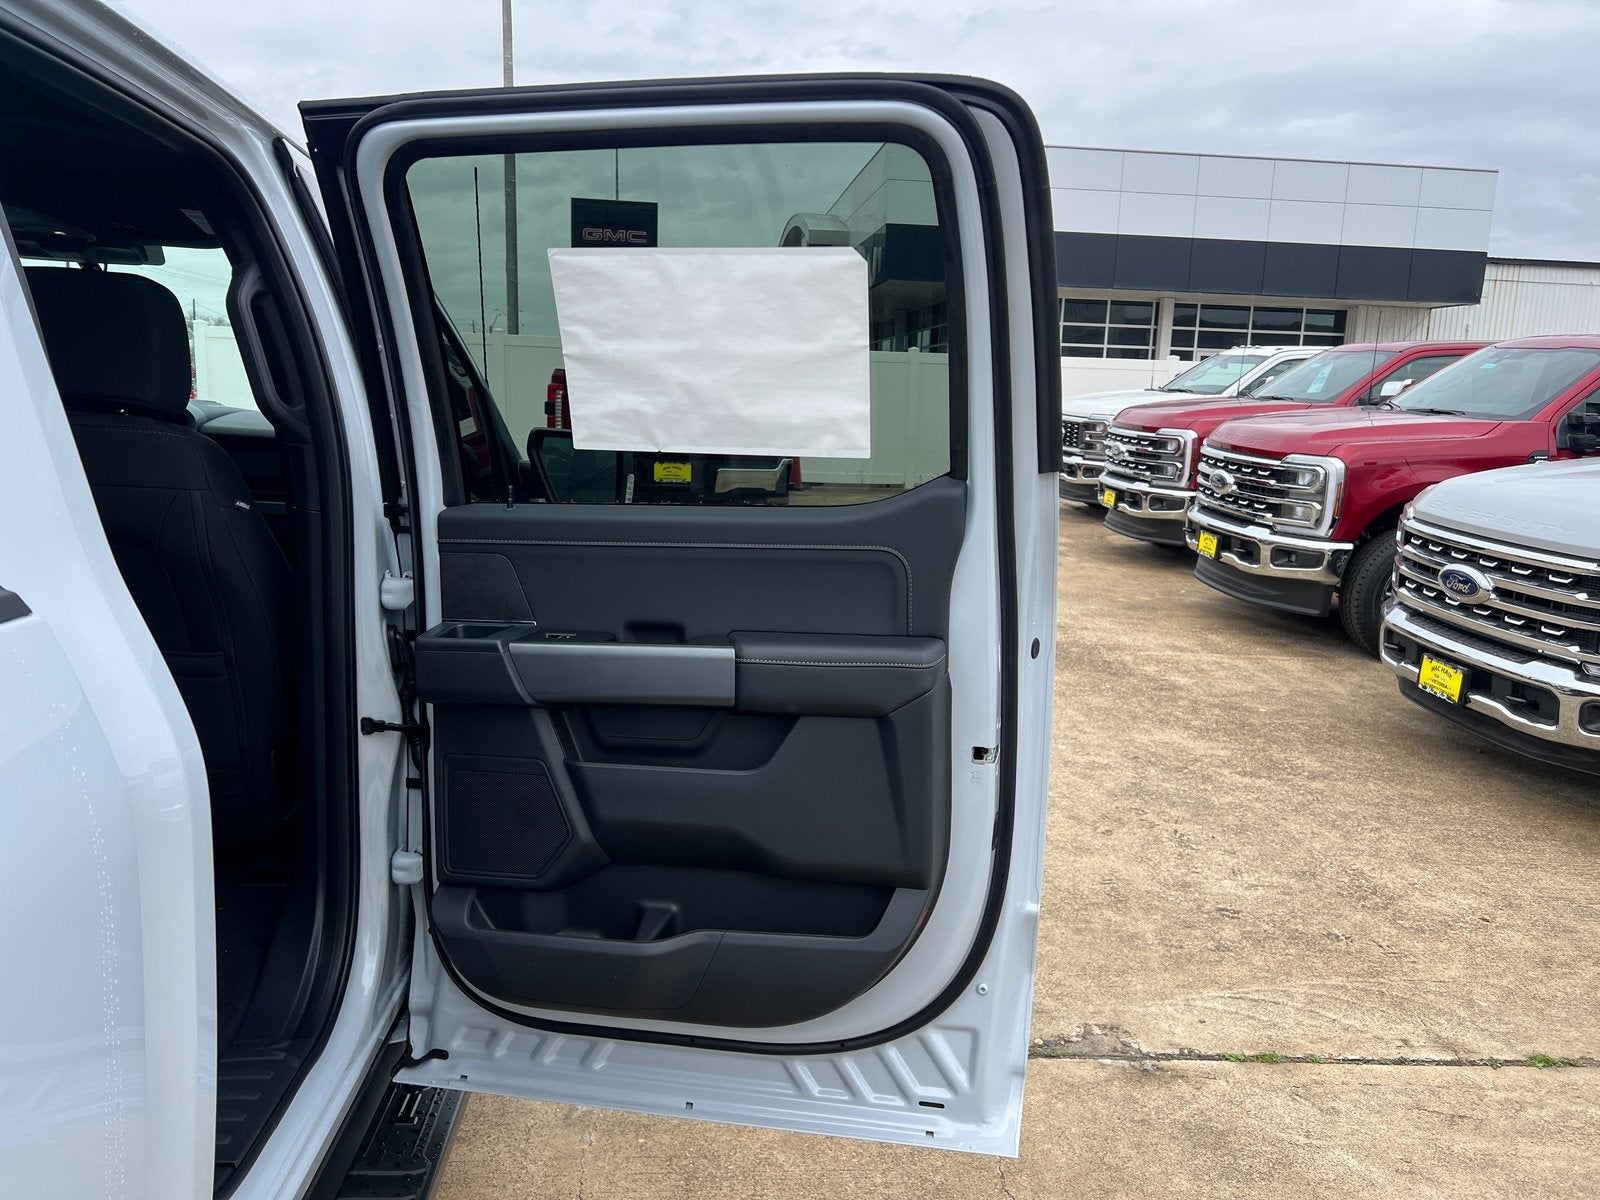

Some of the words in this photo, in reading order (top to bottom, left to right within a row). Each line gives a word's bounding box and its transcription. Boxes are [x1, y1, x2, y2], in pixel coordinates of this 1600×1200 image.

[582, 227, 647, 243] GMC
[1426, 499, 1496, 522] SUPER
[1498, 514, 1577, 538] DUTY
[1446, 573, 1472, 594] Ford
